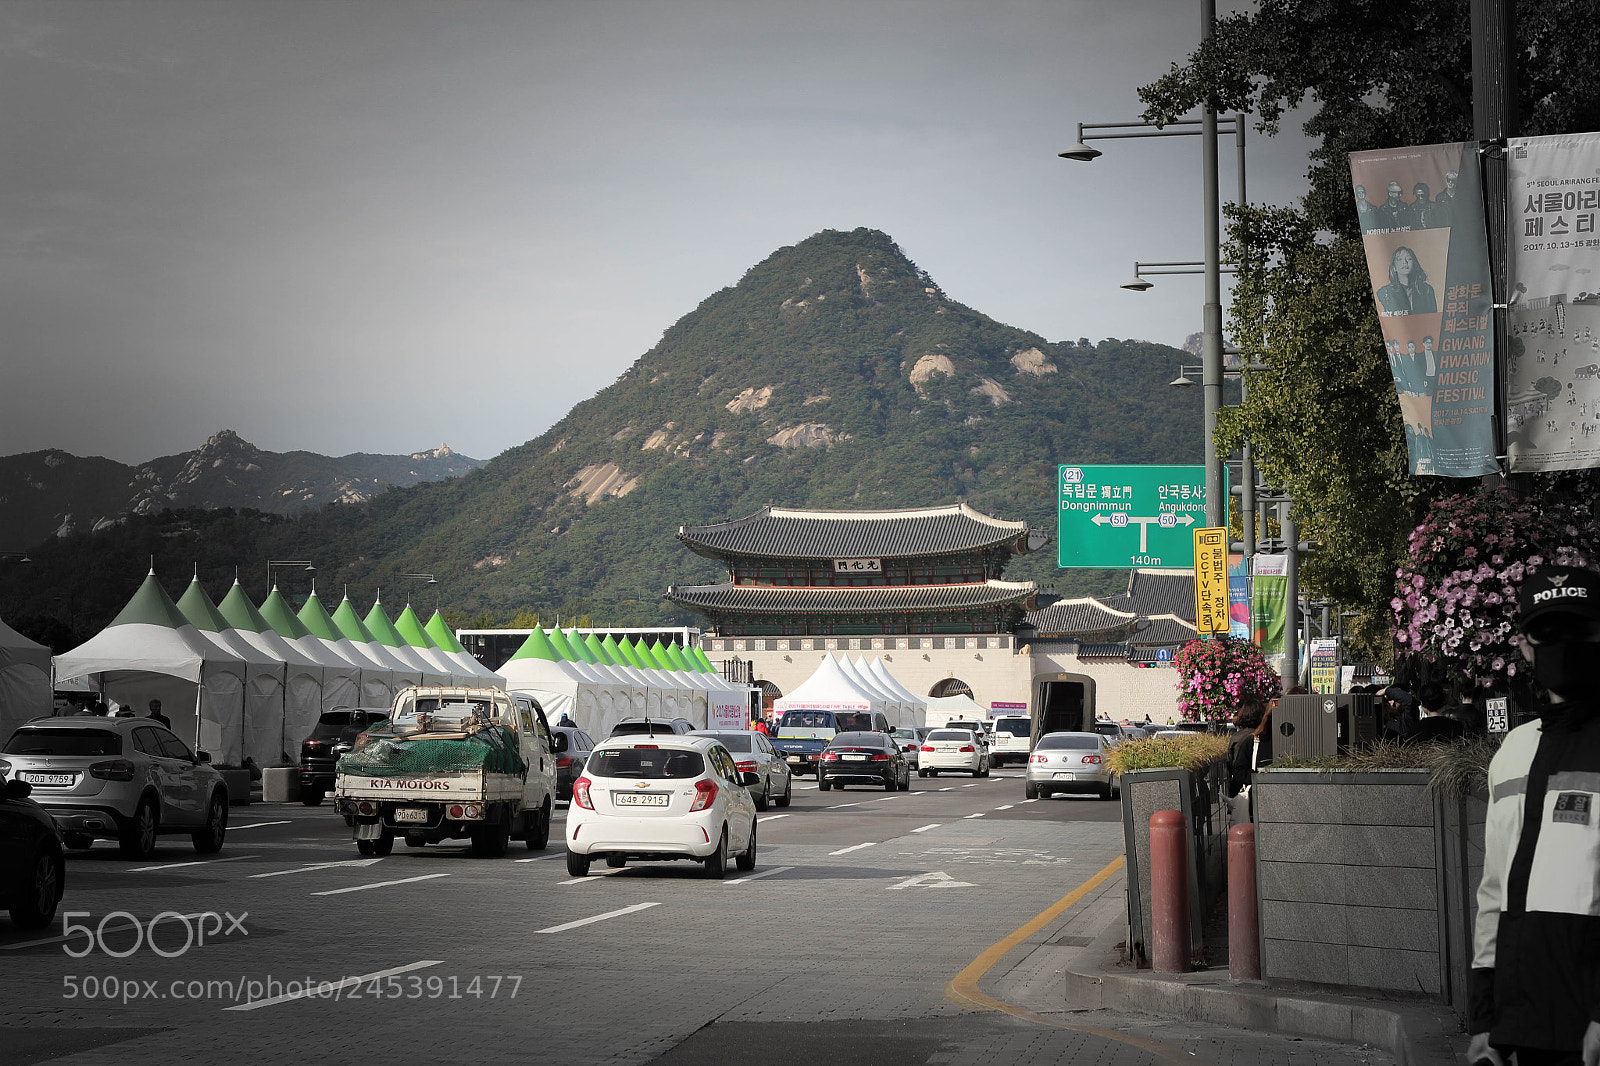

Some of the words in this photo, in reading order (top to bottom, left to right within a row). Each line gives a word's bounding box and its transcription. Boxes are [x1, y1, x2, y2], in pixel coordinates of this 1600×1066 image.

[1536, 180, 1559, 188] SEOUL
[1560, 178, 1592, 187] ARIRANG
[1560, 241, 1584, 250] 13~15
[1447, 283, 1483, 300] 광화문
[1446, 300, 1469, 318] 뮤직
[1444, 314, 1489, 334] 페스티벌
[1442, 335, 1486, 352] GWANG
[1440, 352, 1491, 369] HWAMUN
[1438, 370, 1479, 386] MUSIC
[1436, 386, 1486, 404] FESTIVAL
[1068, 471, 1080, 480] 21
[1062, 484, 1098, 499] 독립문
[1101, 486, 1132, 499] 獨立門
[1062, 500, 1132, 512] Dongnimmun
[1113, 516, 1125, 525] 50
[1162, 516, 1174, 525] 50
[1130, 556, 1162, 566] 140m
[1533, 587, 1588, 604] POLICE
[1490, 716, 1506, 730] 2-5
[48, 775, 69, 784] 9759
[370, 780, 392, 789] KIA
[396, 780, 450, 790] MOTORS
[642, 796, 664, 804] 2915
